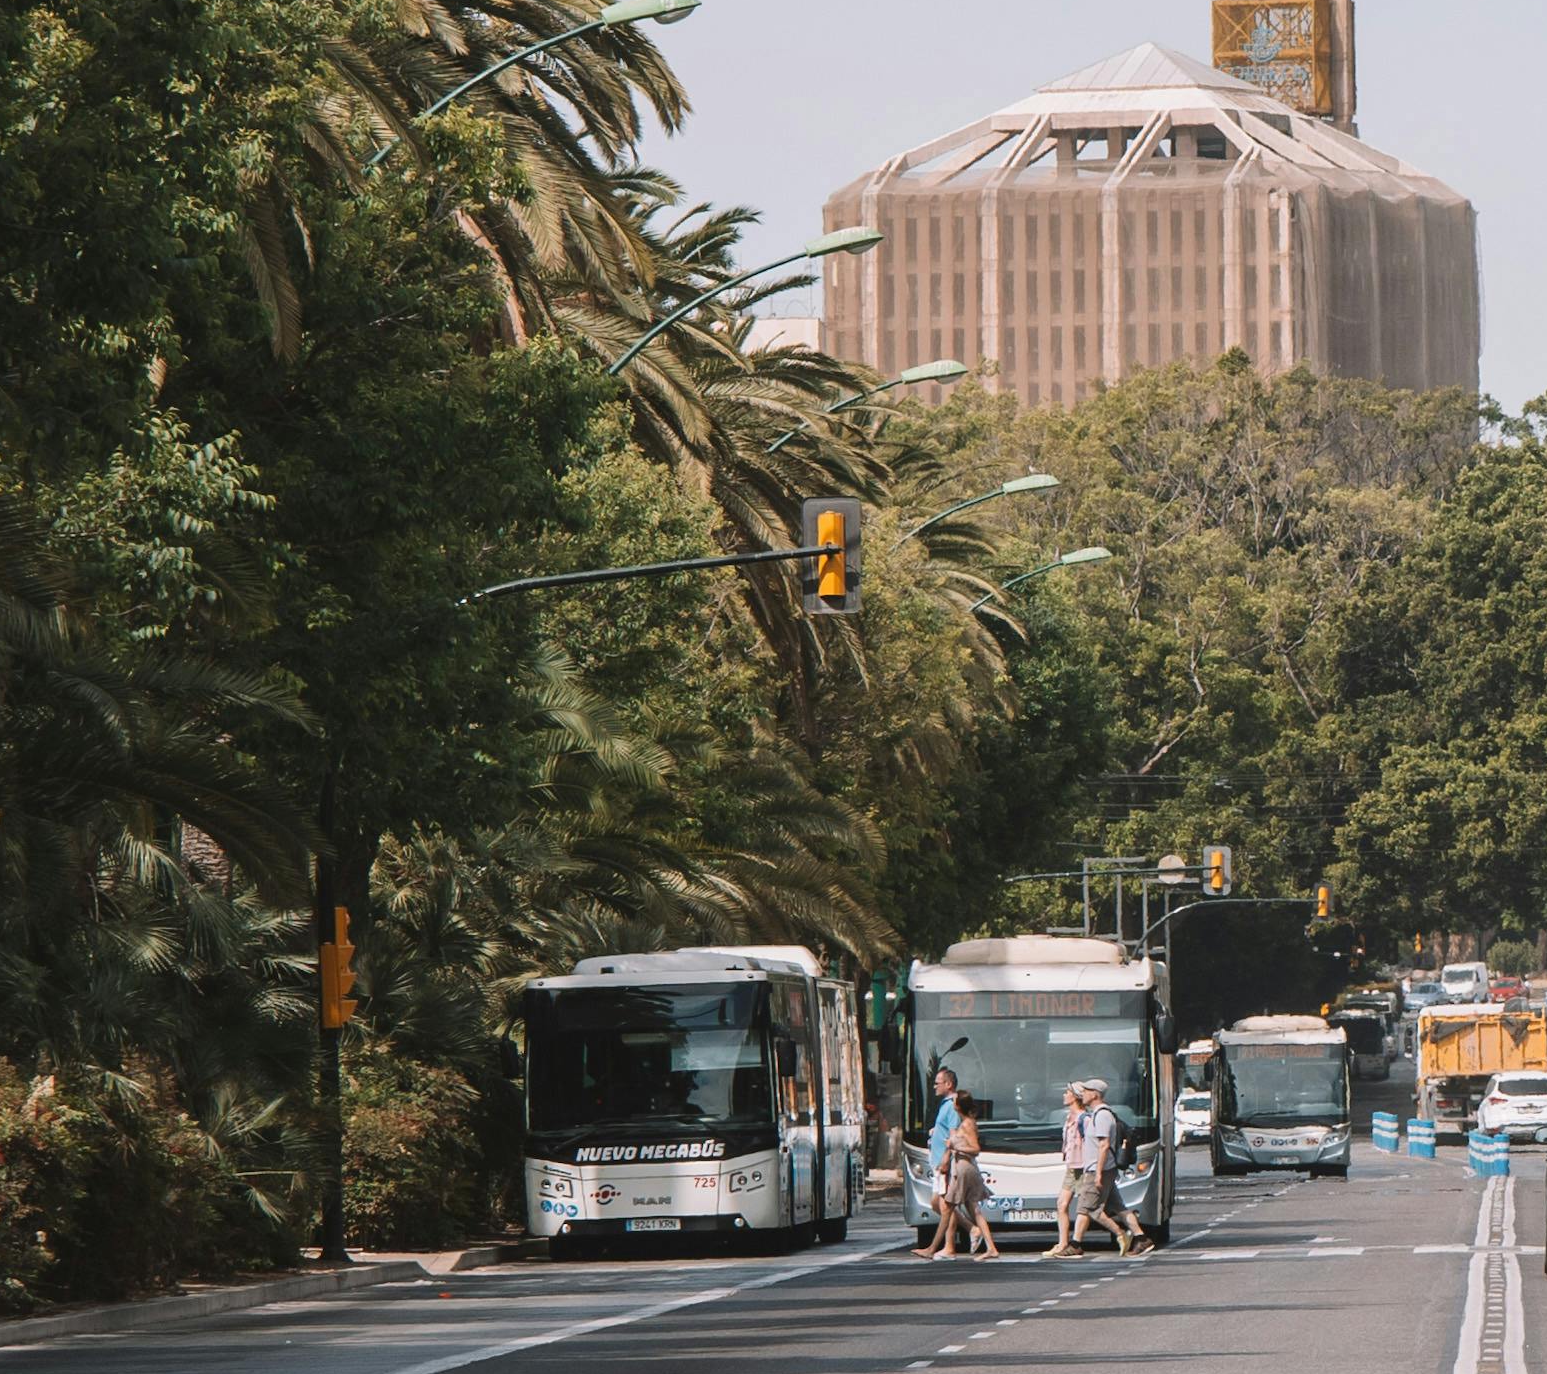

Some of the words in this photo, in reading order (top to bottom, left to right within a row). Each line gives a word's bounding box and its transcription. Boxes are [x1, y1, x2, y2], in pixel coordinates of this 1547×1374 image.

[949, 993, 975, 1018] 32
[991, 993, 1095, 1018] LIMONAR
[576, 1146, 638, 1162] NUEVO
[640, 1139, 726, 1160] MEGABÚS
[694, 1177, 717, 1189] 725
[633, 1196, 672, 1206] MAN
